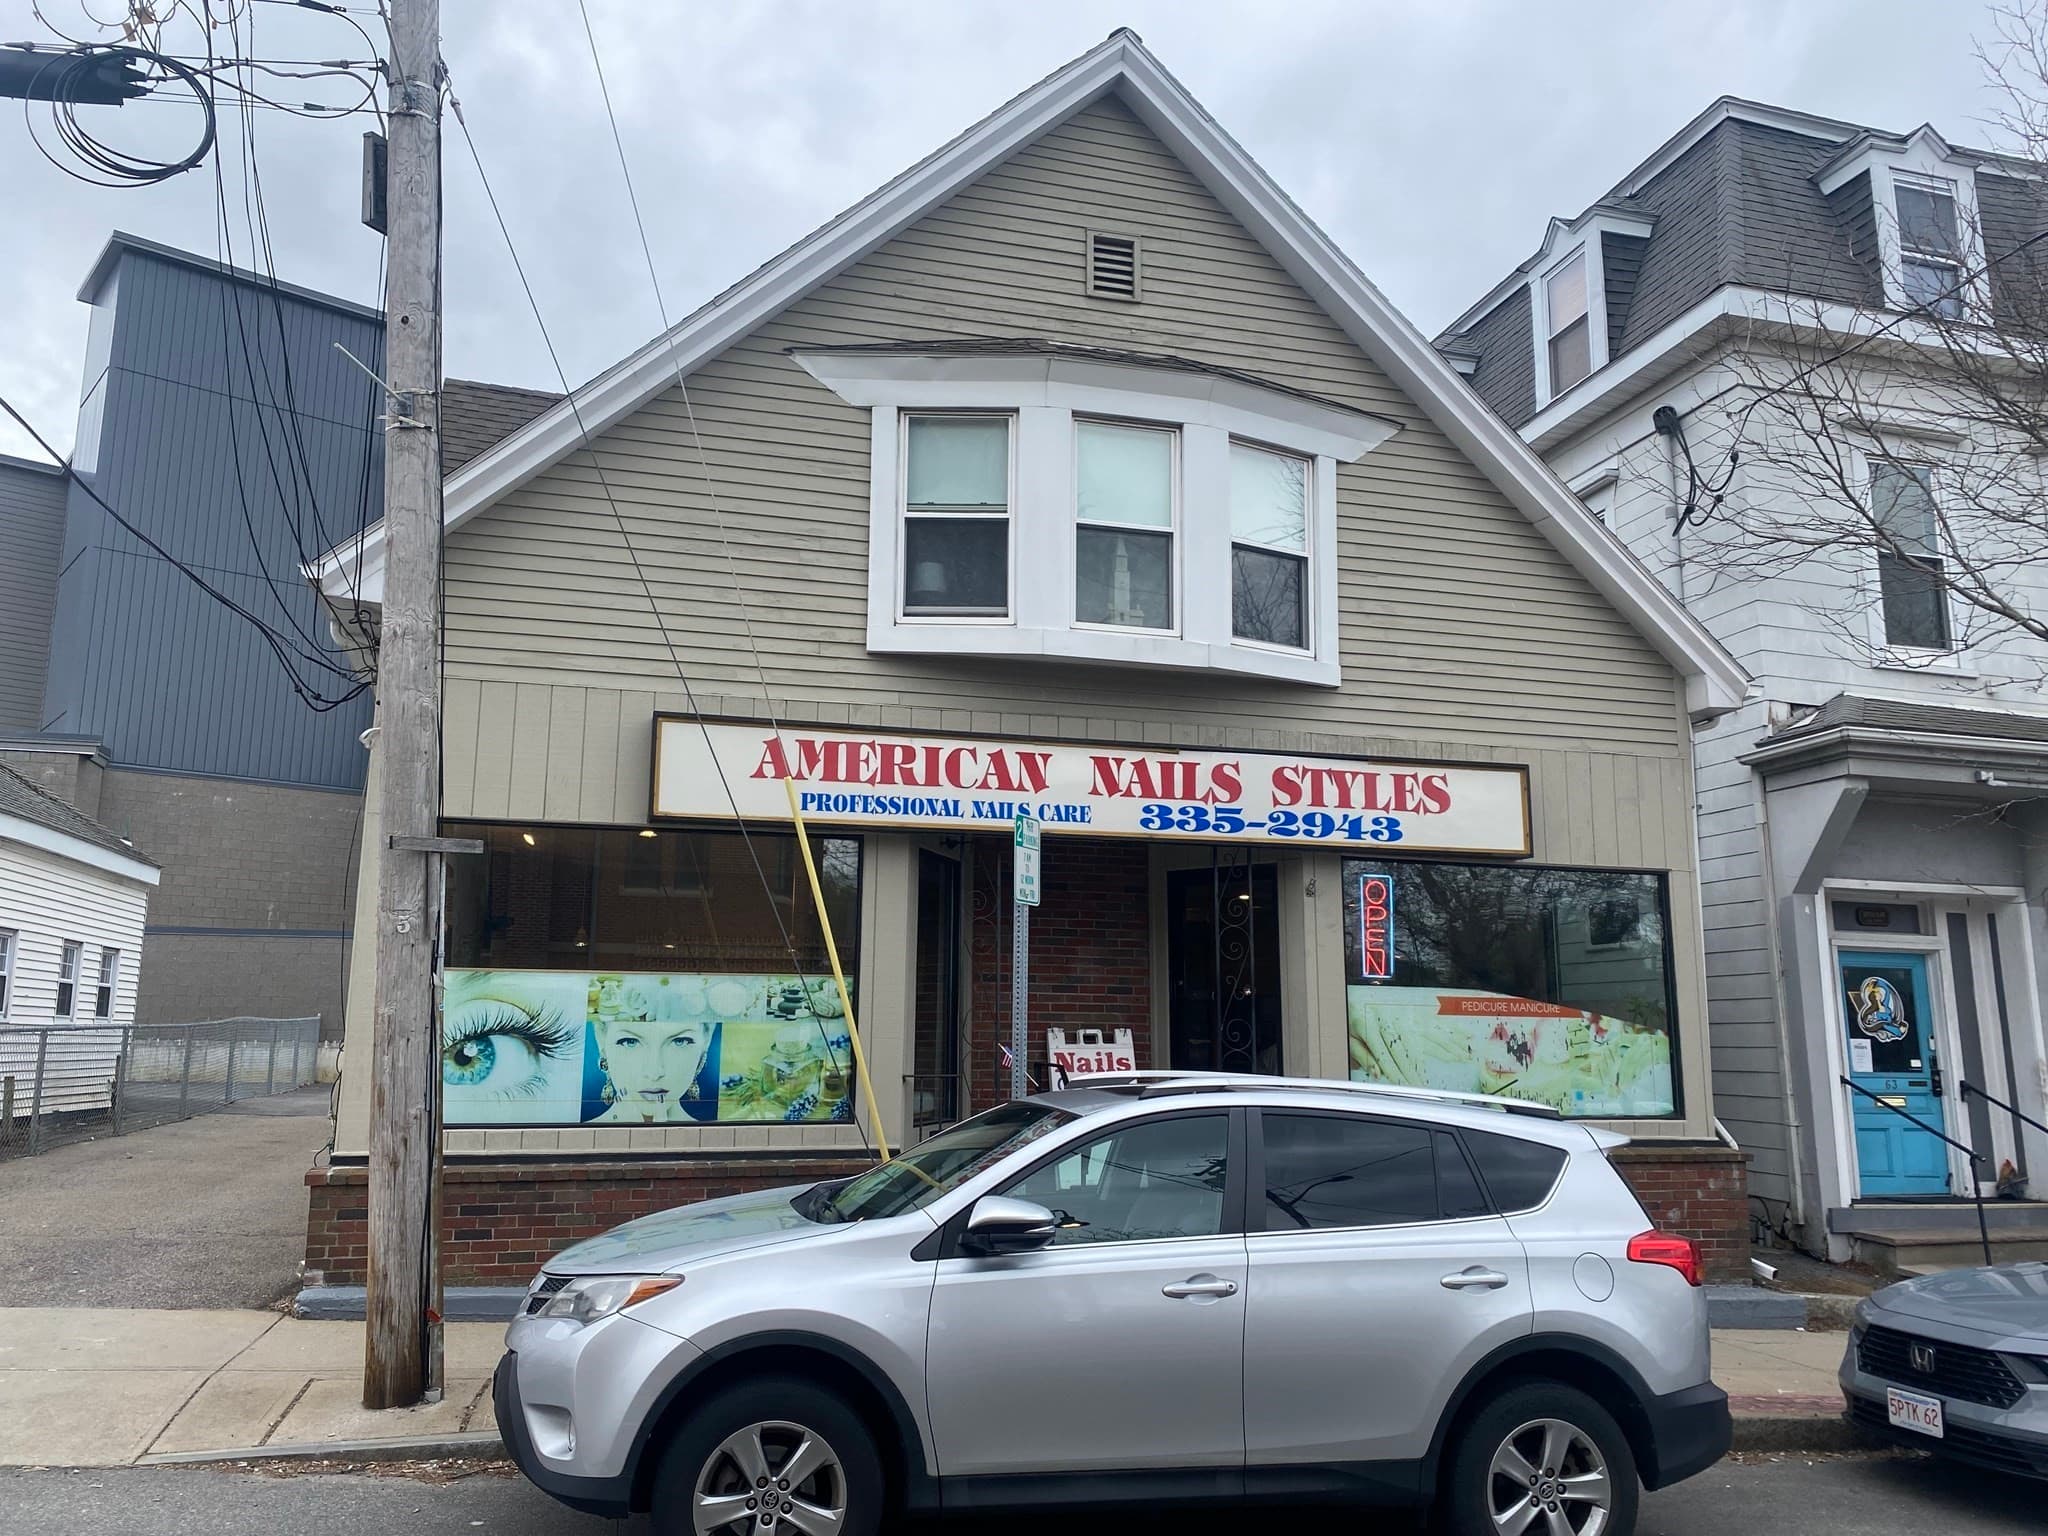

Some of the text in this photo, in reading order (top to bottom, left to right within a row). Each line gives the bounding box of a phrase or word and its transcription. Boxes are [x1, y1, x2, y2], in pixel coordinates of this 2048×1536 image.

[749, 735, 1452, 816] AMERICAN NAILS STYLES
[800, 791, 1093, 824] PROFESSIONAL NAILS CARE
[1016, 820, 1022, 842] 2
[1139, 803, 1404, 843] 335-2943
[1364, 880, 1387, 976] OPEN
[1462, 1001, 1560, 1014] PEDICURE MANICURE
[1054, 1051, 1132, 1073] Nails
[1885, 1079, 1898, 1090] 63
[1890, 1398, 1920, 1422] 5PTK
[1924, 1407, 1939, 1427] 62
